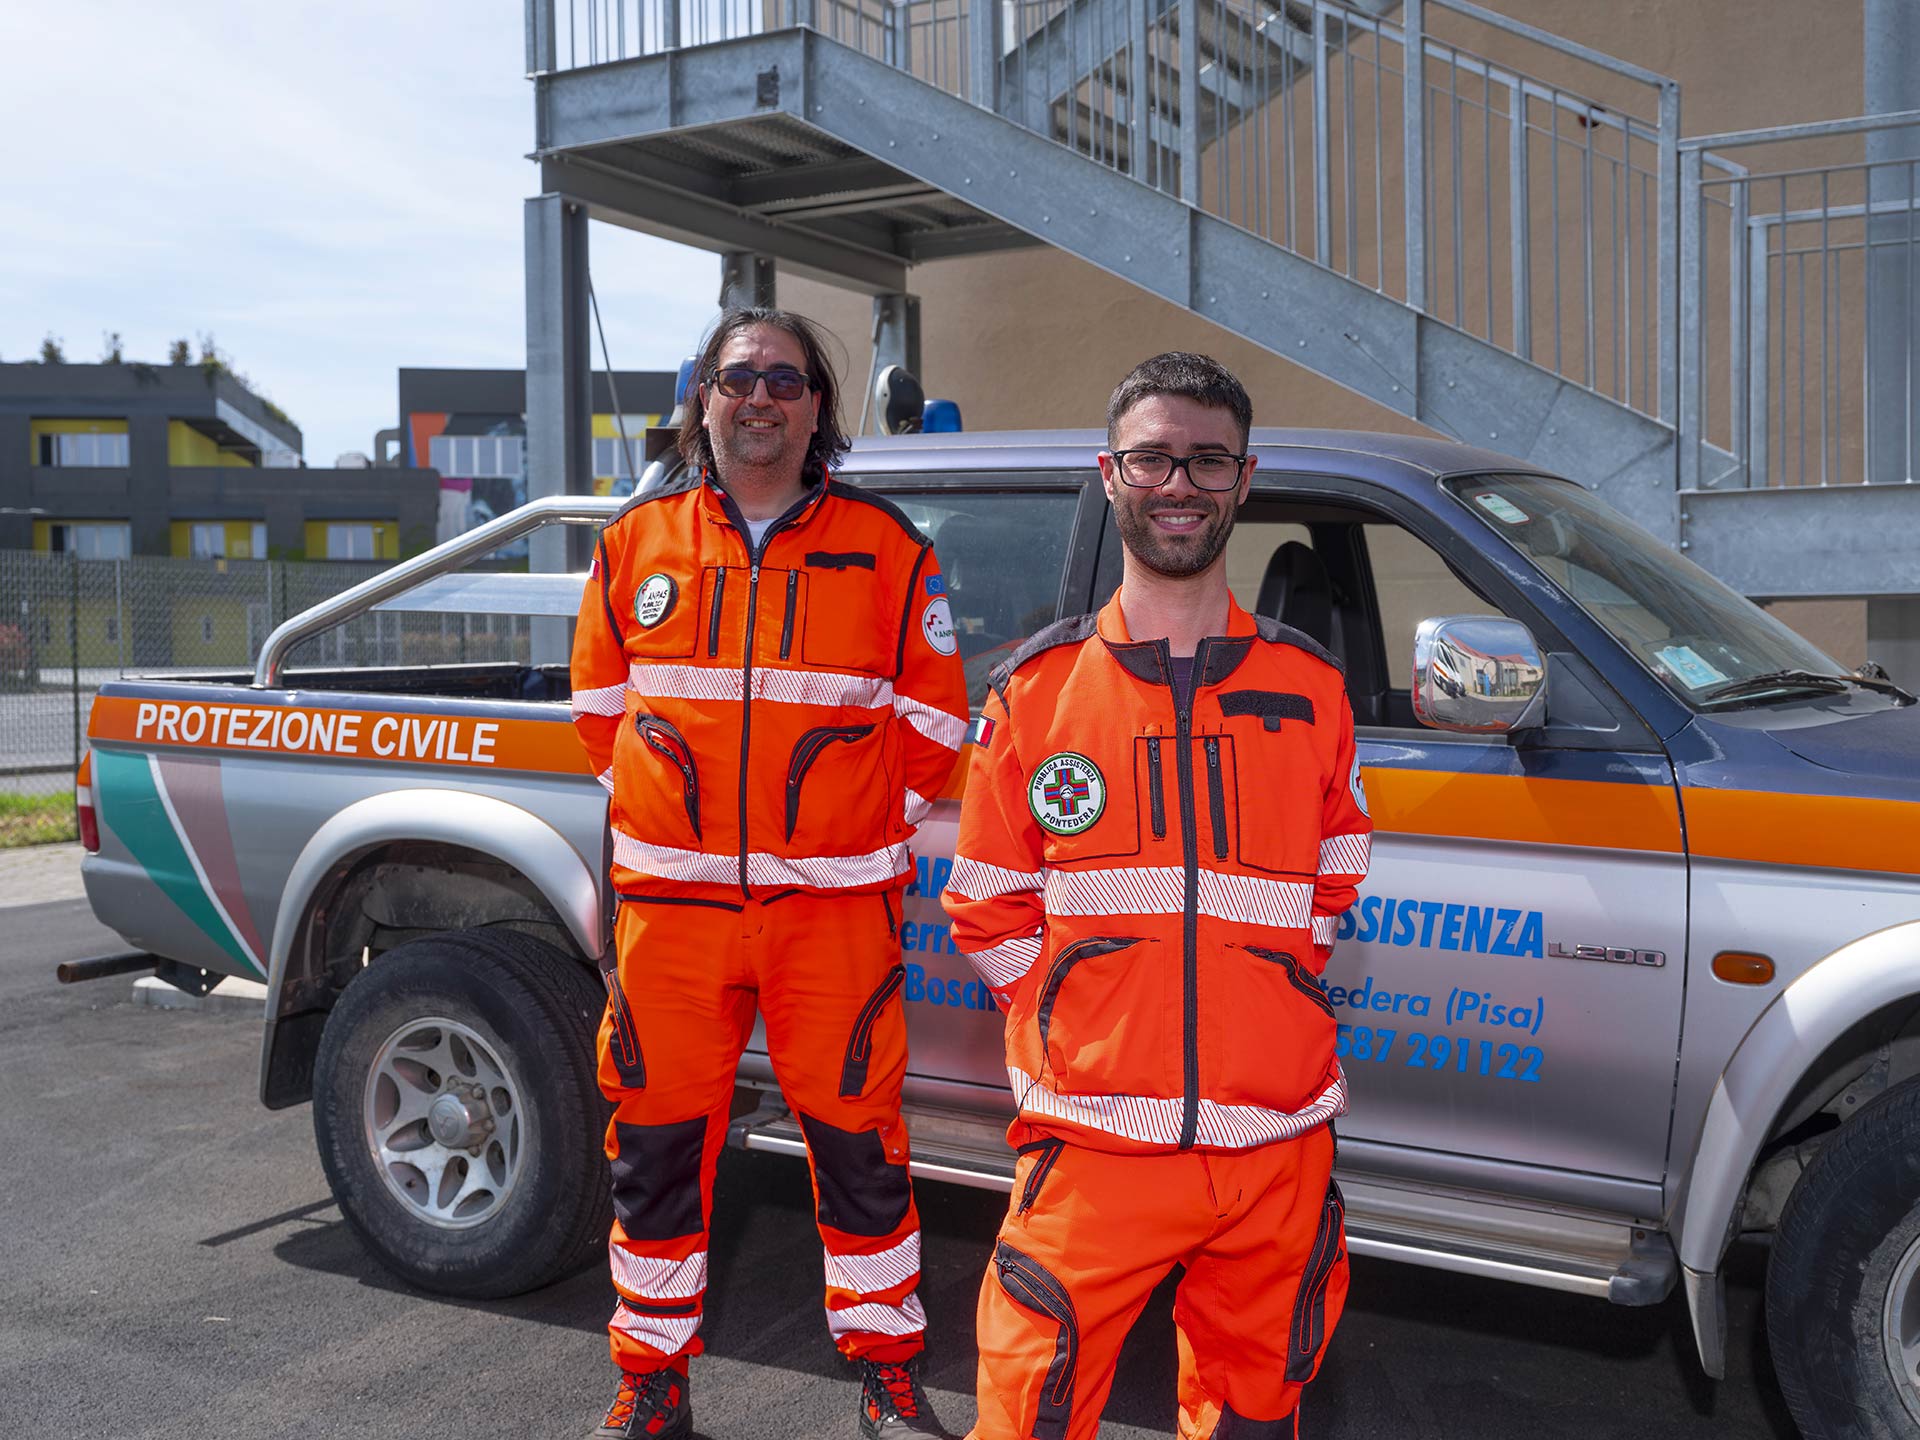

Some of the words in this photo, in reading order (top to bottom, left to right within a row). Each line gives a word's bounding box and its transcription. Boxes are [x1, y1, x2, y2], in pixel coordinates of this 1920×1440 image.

[135, 703, 362, 754] PROTEZIONE
[371, 716, 500, 763] CIVILE
[1034, 761, 1059, 790] PUBBLICA
[1060, 759, 1097, 783] ASSISTENZA
[1043, 806, 1096, 828] PONTEDERA
[1548, 942, 1666, 967] L200
[906, 963, 1003, 1013] Bosch
[1445, 987, 1544, 1036] (Pisa)
[1405, 1032, 1545, 1083] 291122
